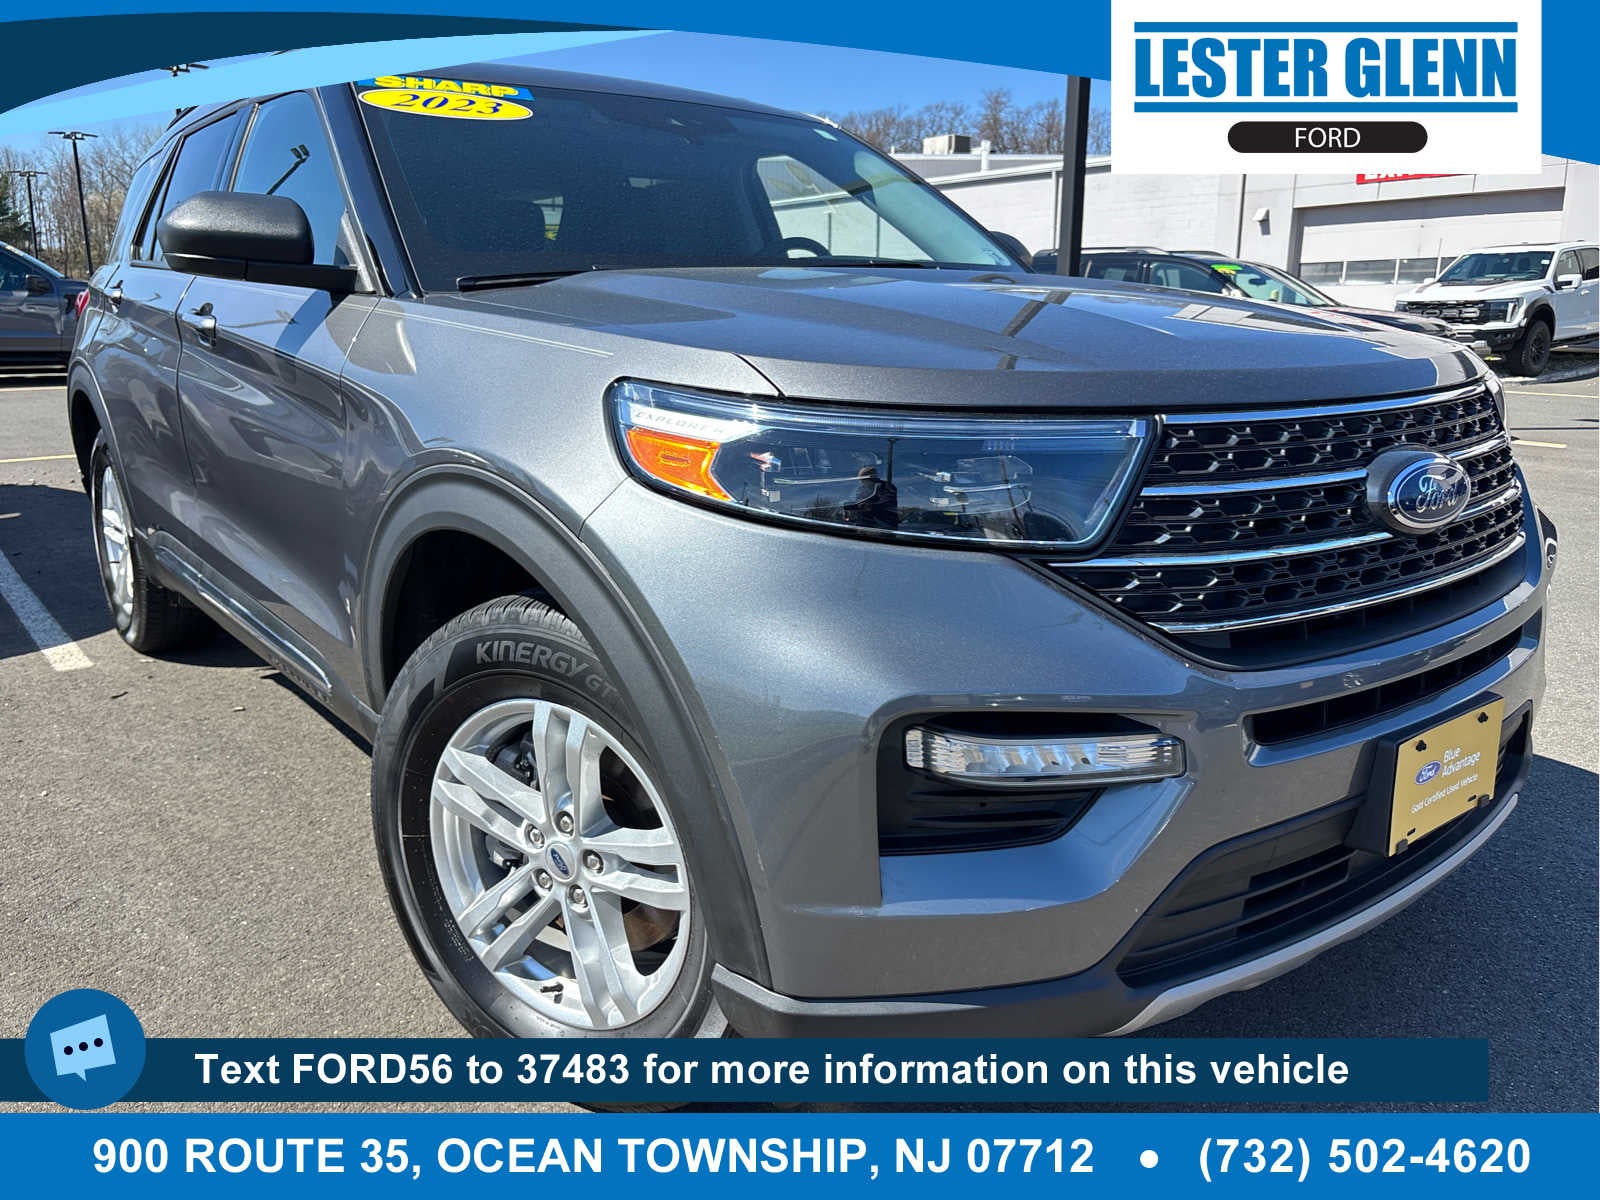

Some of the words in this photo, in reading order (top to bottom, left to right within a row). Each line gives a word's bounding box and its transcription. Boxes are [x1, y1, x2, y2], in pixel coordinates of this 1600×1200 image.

[375, 76, 519, 97] SHARP
[391, 93, 503, 115] 2023
[1416, 474, 1460, 513] Ford
[476, 640, 589, 677] KINERGY
[585, 674, 619, 699] GT
[1441, 752, 1480, 777] Advantage
[1443, 748, 1461, 763] Blue
[1419, 764, 1438, 783] Ford
